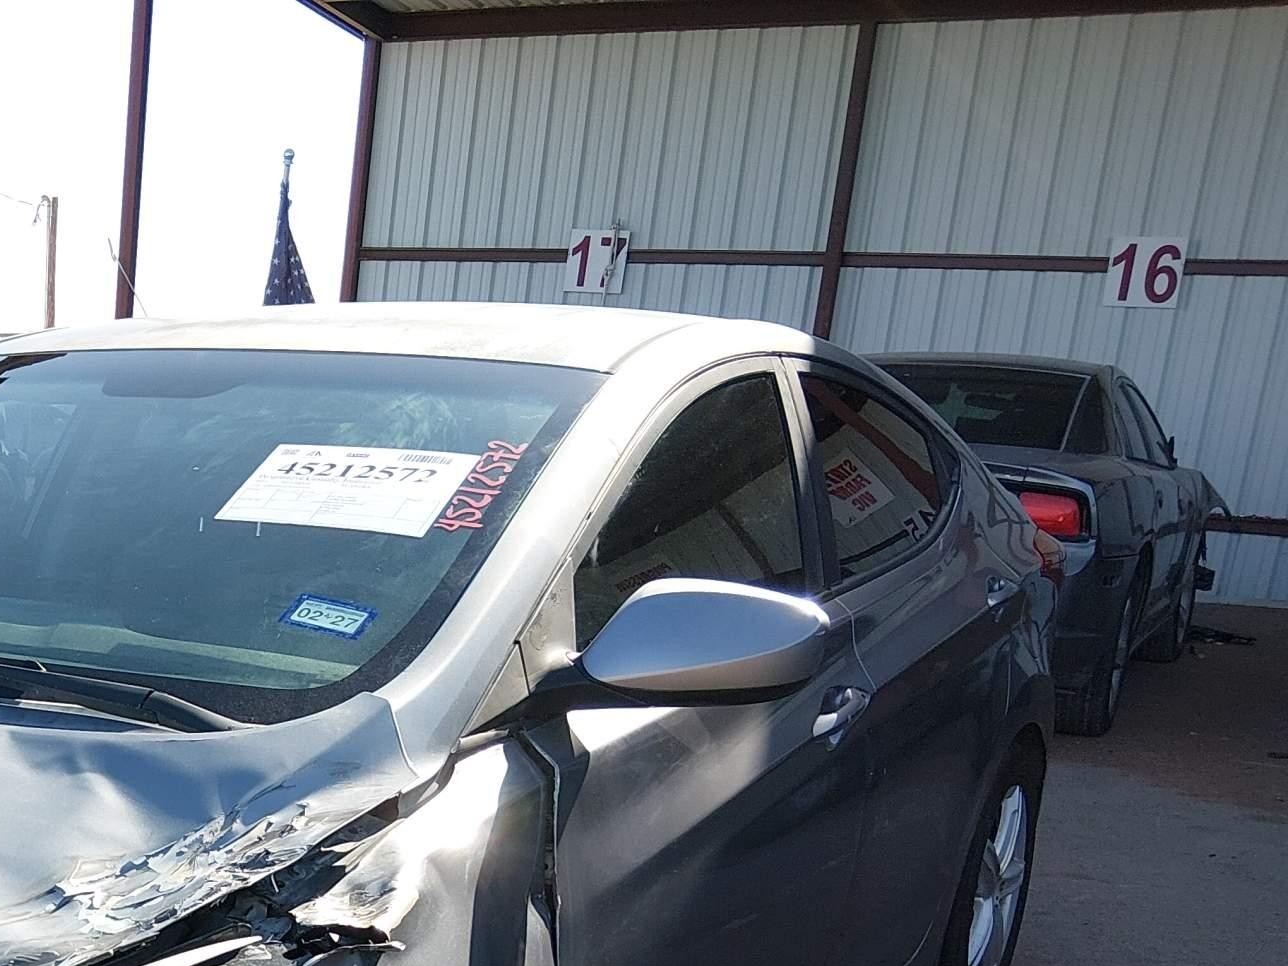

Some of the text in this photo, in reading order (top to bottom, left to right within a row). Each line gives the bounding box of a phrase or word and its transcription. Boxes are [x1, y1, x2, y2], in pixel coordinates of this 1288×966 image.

[571, 235, 628, 288] 17
[1112, 243, 1182, 304] 16
[277, 461, 438, 483] 45212572
[433, 440, 529, 531] 45212572
